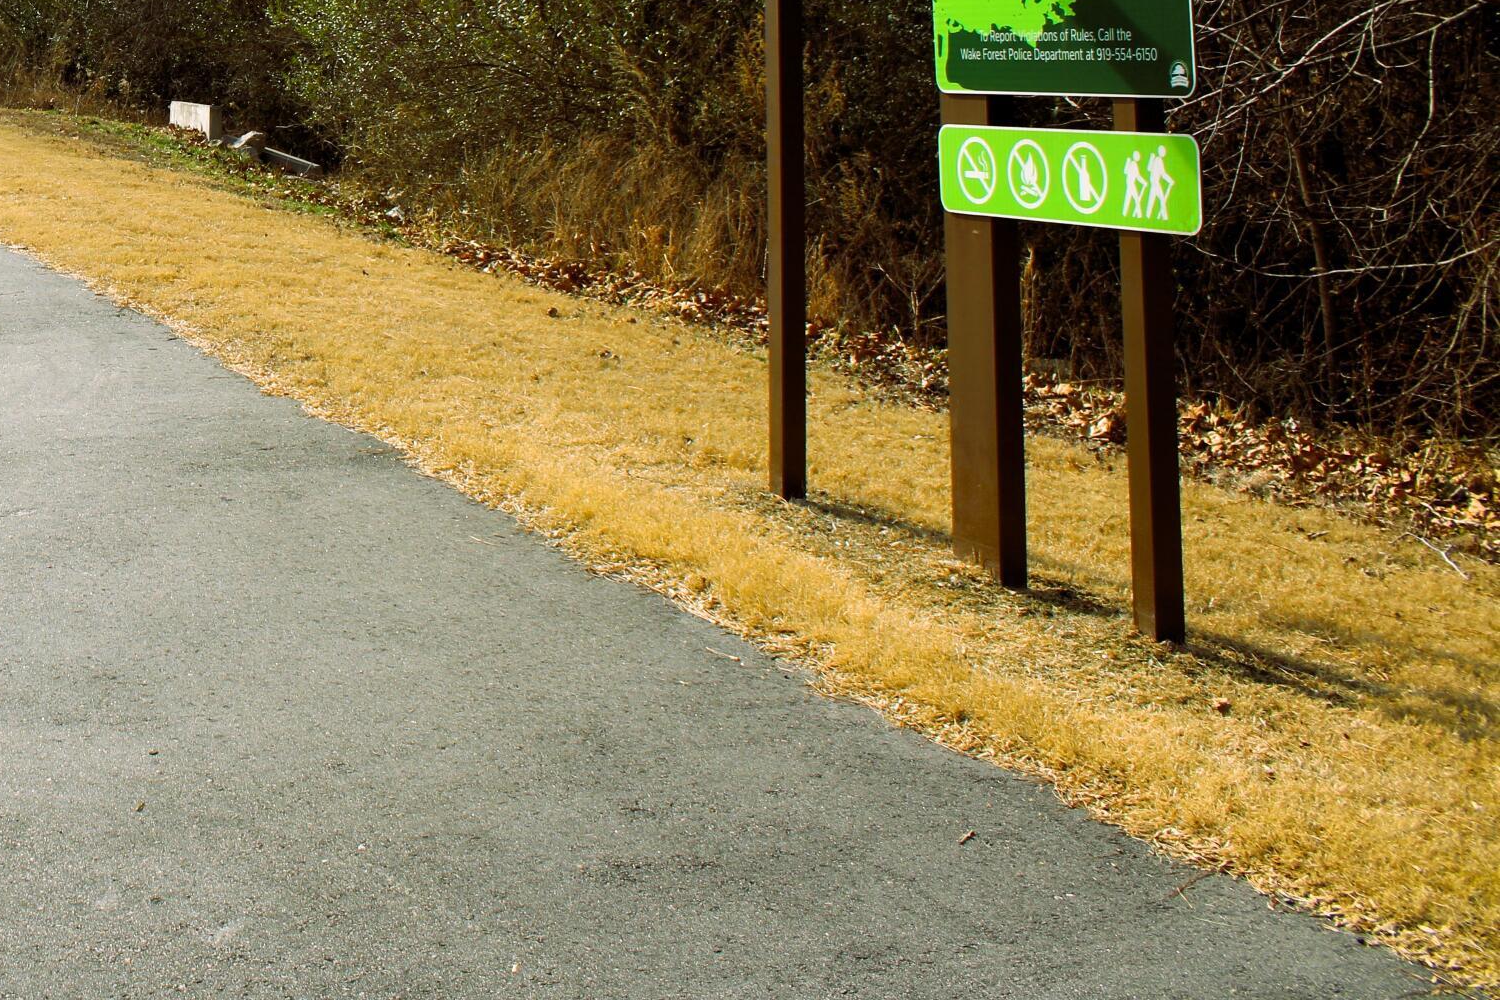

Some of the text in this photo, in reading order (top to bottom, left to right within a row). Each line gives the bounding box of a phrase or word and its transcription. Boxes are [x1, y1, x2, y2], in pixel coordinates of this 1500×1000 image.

[990, 30, 1016, 44] Report
[1059, 28, 1069, 41] of
[1070, 28, 1097, 42] Rules,
[1097, 28, 1114, 41] Call
[1116, 28, 1132, 41] the
[960, 47, 1158, 62] Wake Forest Police Department at 919-554-6150
